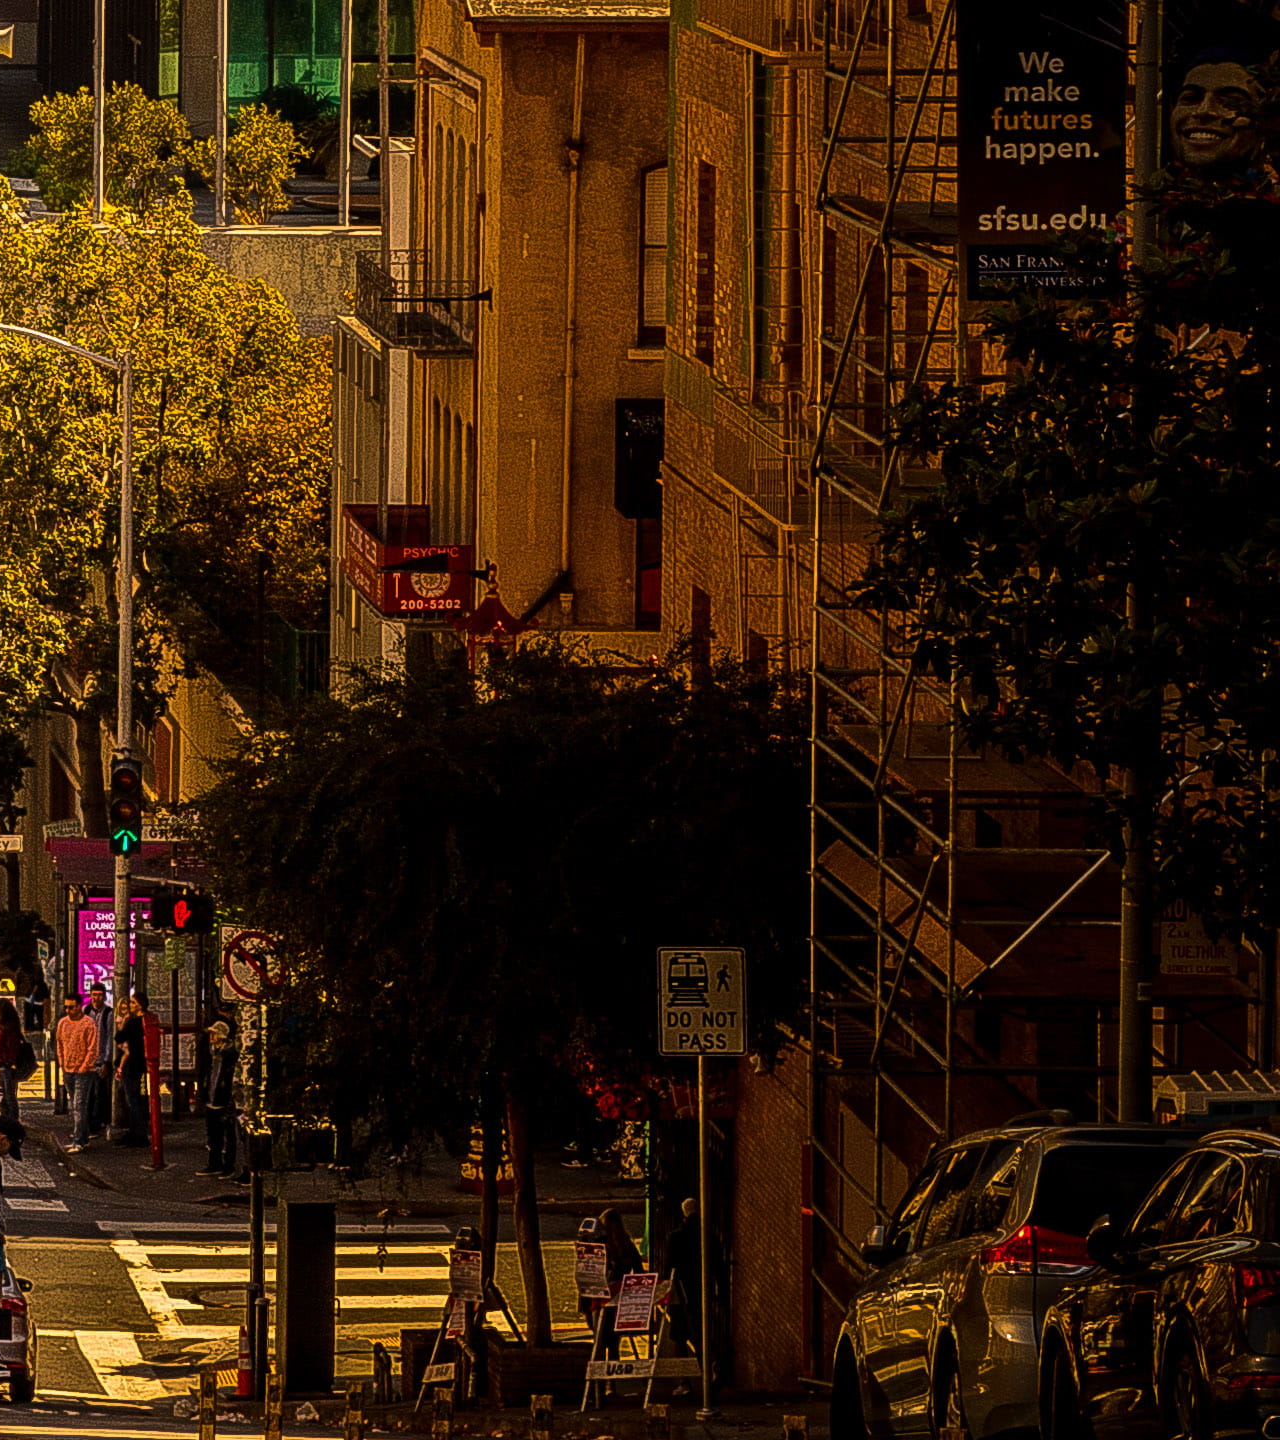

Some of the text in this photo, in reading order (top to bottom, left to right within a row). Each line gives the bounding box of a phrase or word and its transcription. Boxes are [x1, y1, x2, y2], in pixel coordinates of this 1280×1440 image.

[1017, 50, 1065, 74] We
[1002, 78, 1081, 103] make
[991, 106, 1094, 132] futures
[984, 135, 1101, 166] happen.
[977, 204, 1108, 232] sfsu.edu
[977, 254, 1012, 269] SAN
[400, 599, 462, 610] 200-5202
[667, 1011, 738, 1028] DO NOT
[679, 1033, 727, 1050] PASS
